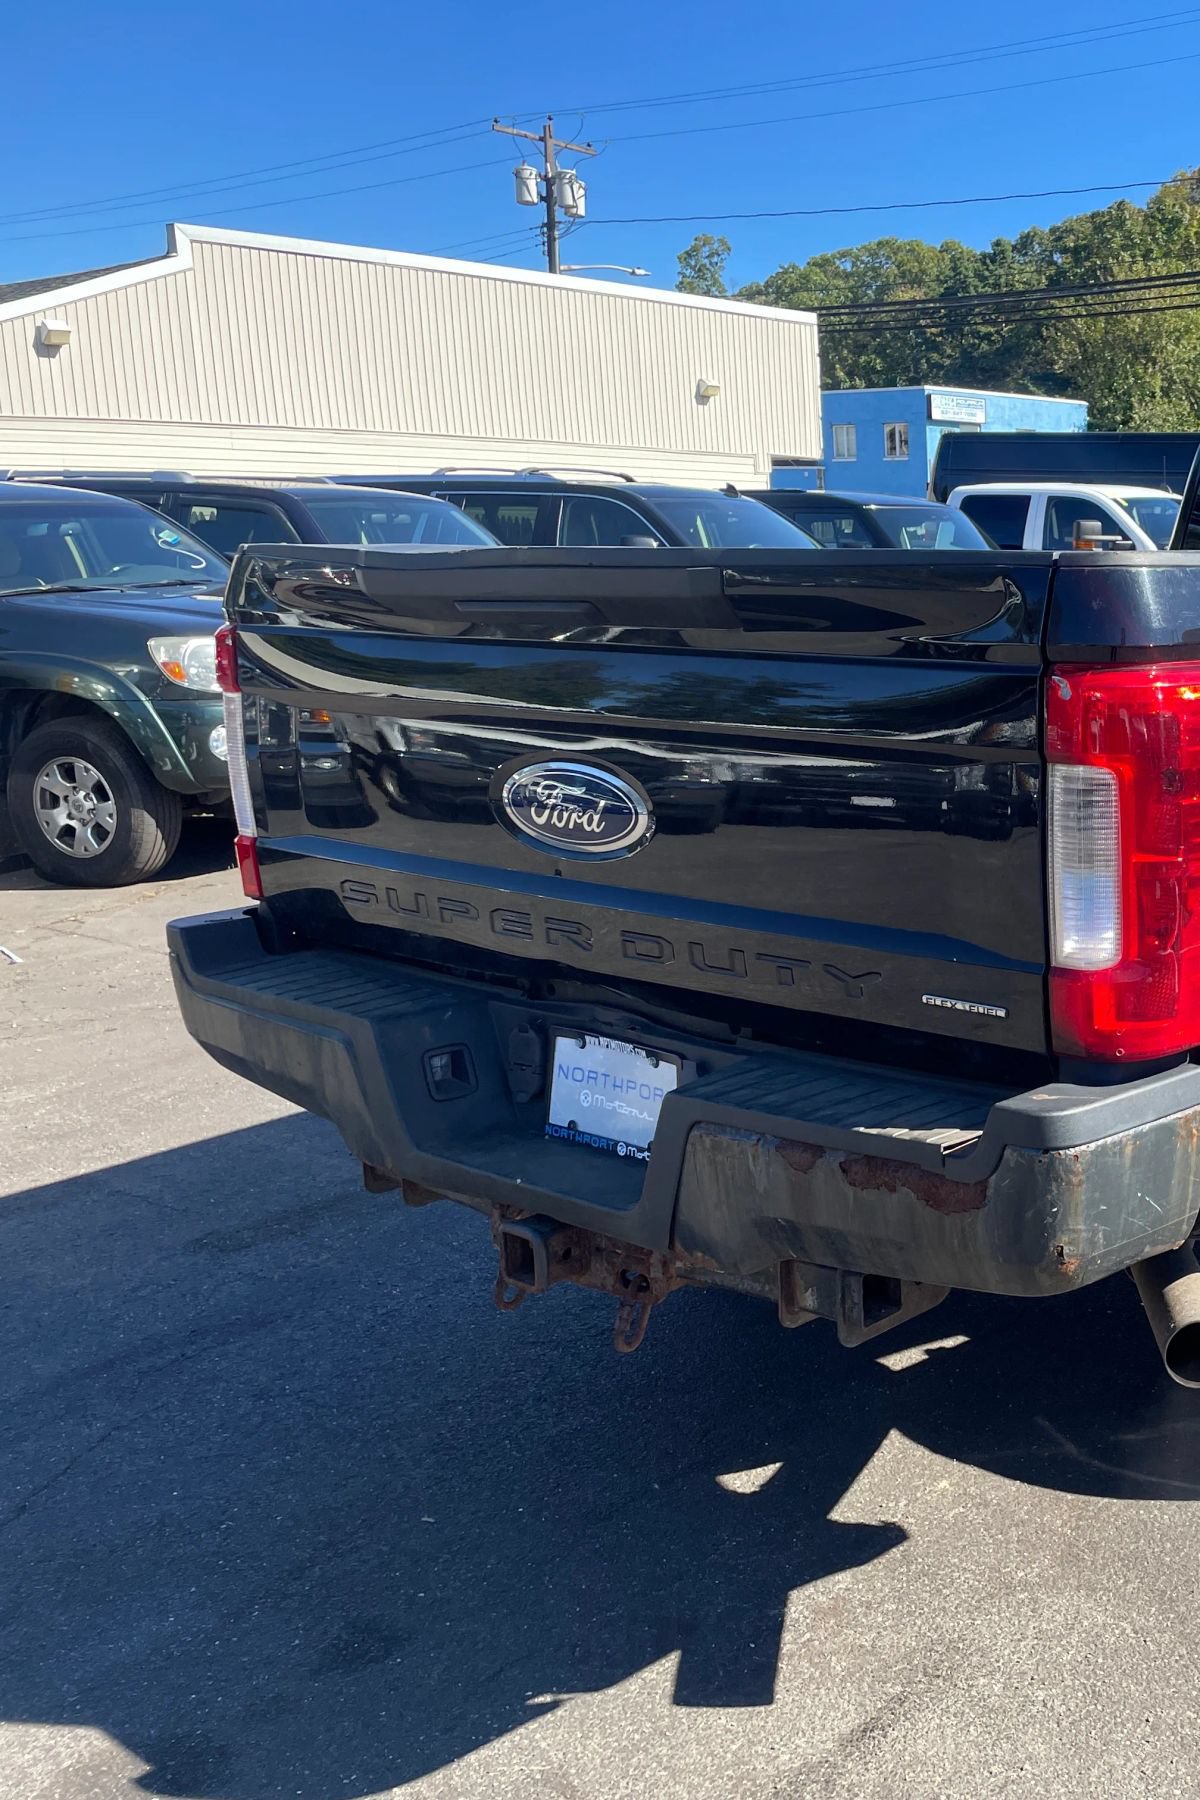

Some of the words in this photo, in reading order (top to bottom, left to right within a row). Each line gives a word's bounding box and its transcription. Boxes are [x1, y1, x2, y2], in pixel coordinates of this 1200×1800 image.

[530, 779, 606, 833] Ford
[340, 878, 594, 951] SUPER
[621, 929, 882, 998] DUTY
[557, 1064, 665, 1101] NORTHPOR
[544, 1124, 616, 1151] NORTHPORT
